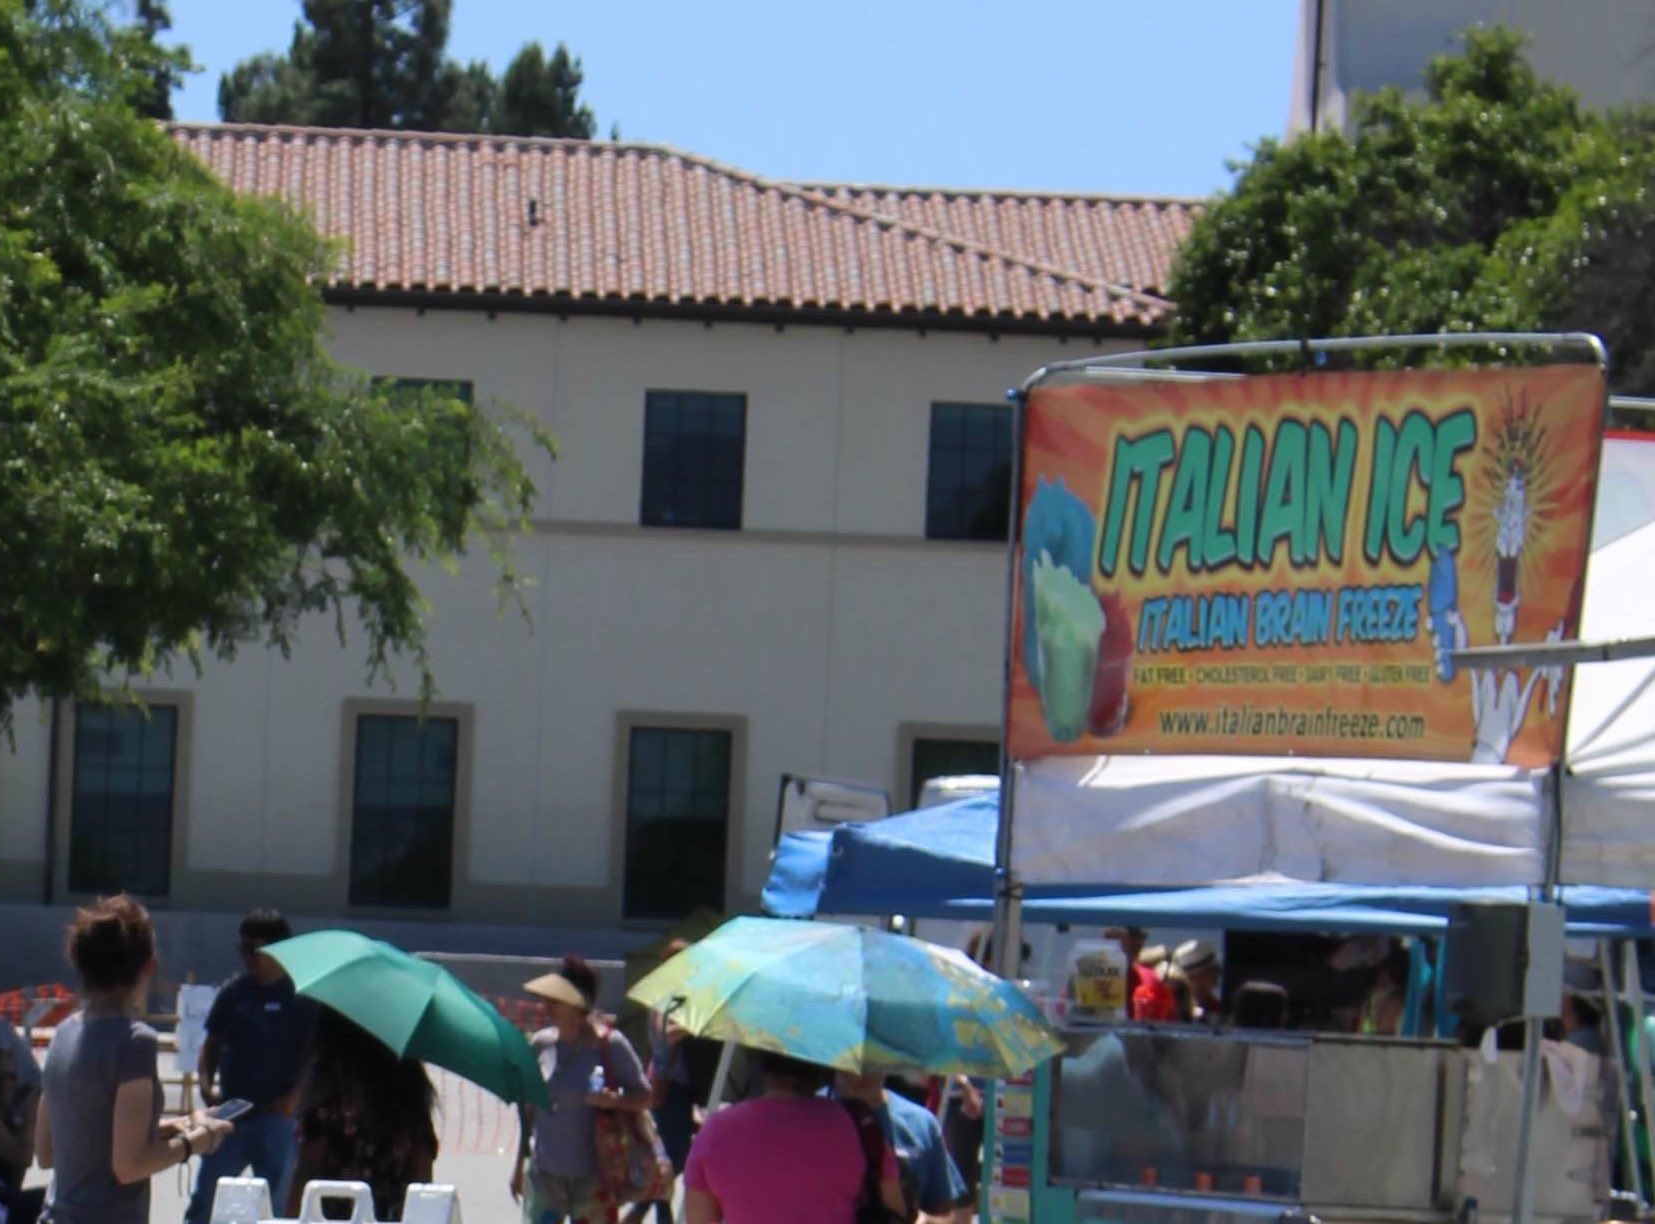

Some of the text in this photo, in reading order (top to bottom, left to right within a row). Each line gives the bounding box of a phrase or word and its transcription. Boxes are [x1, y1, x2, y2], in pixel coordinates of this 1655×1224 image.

[1099, 406, 1478, 577] ITALIAN ICE
[1136, 584, 1424, 652] ITALIAN BRAIN FREEZE
[1134, 666, 1153, 684] FAT
[1156, 666, 1186, 684] FREE
[1159, 704, 1424, 738] www.italianbrainfreeze.com
